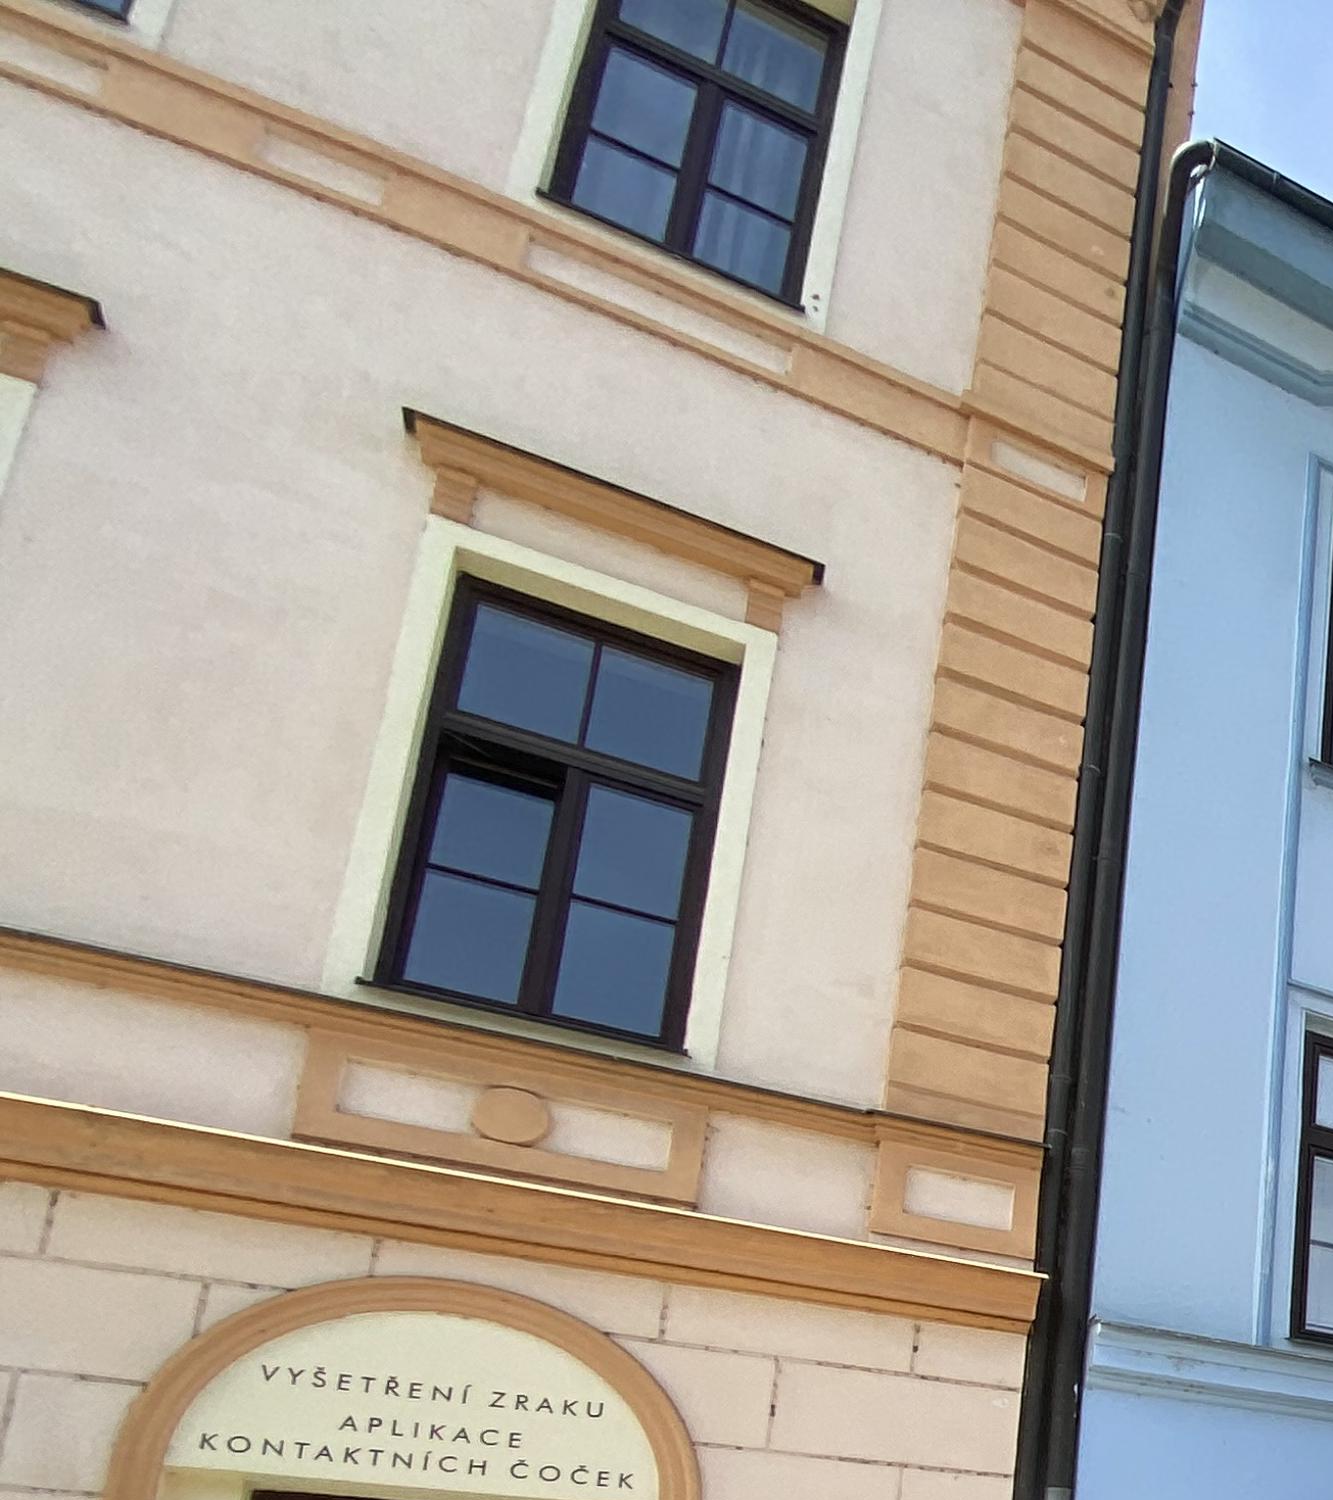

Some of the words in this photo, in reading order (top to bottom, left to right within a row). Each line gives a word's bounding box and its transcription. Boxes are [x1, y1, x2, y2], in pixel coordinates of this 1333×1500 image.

[261, 1363, 473, 1405] VYŠETŘENÍ
[487, 1391, 605, 1419] ZRAKU
[338, 1415, 524, 1449] APLIKACE
[199, 1432, 488, 1476] KONTAKTNÍCH
[509, 1459, 635, 1490] ČOČEK
